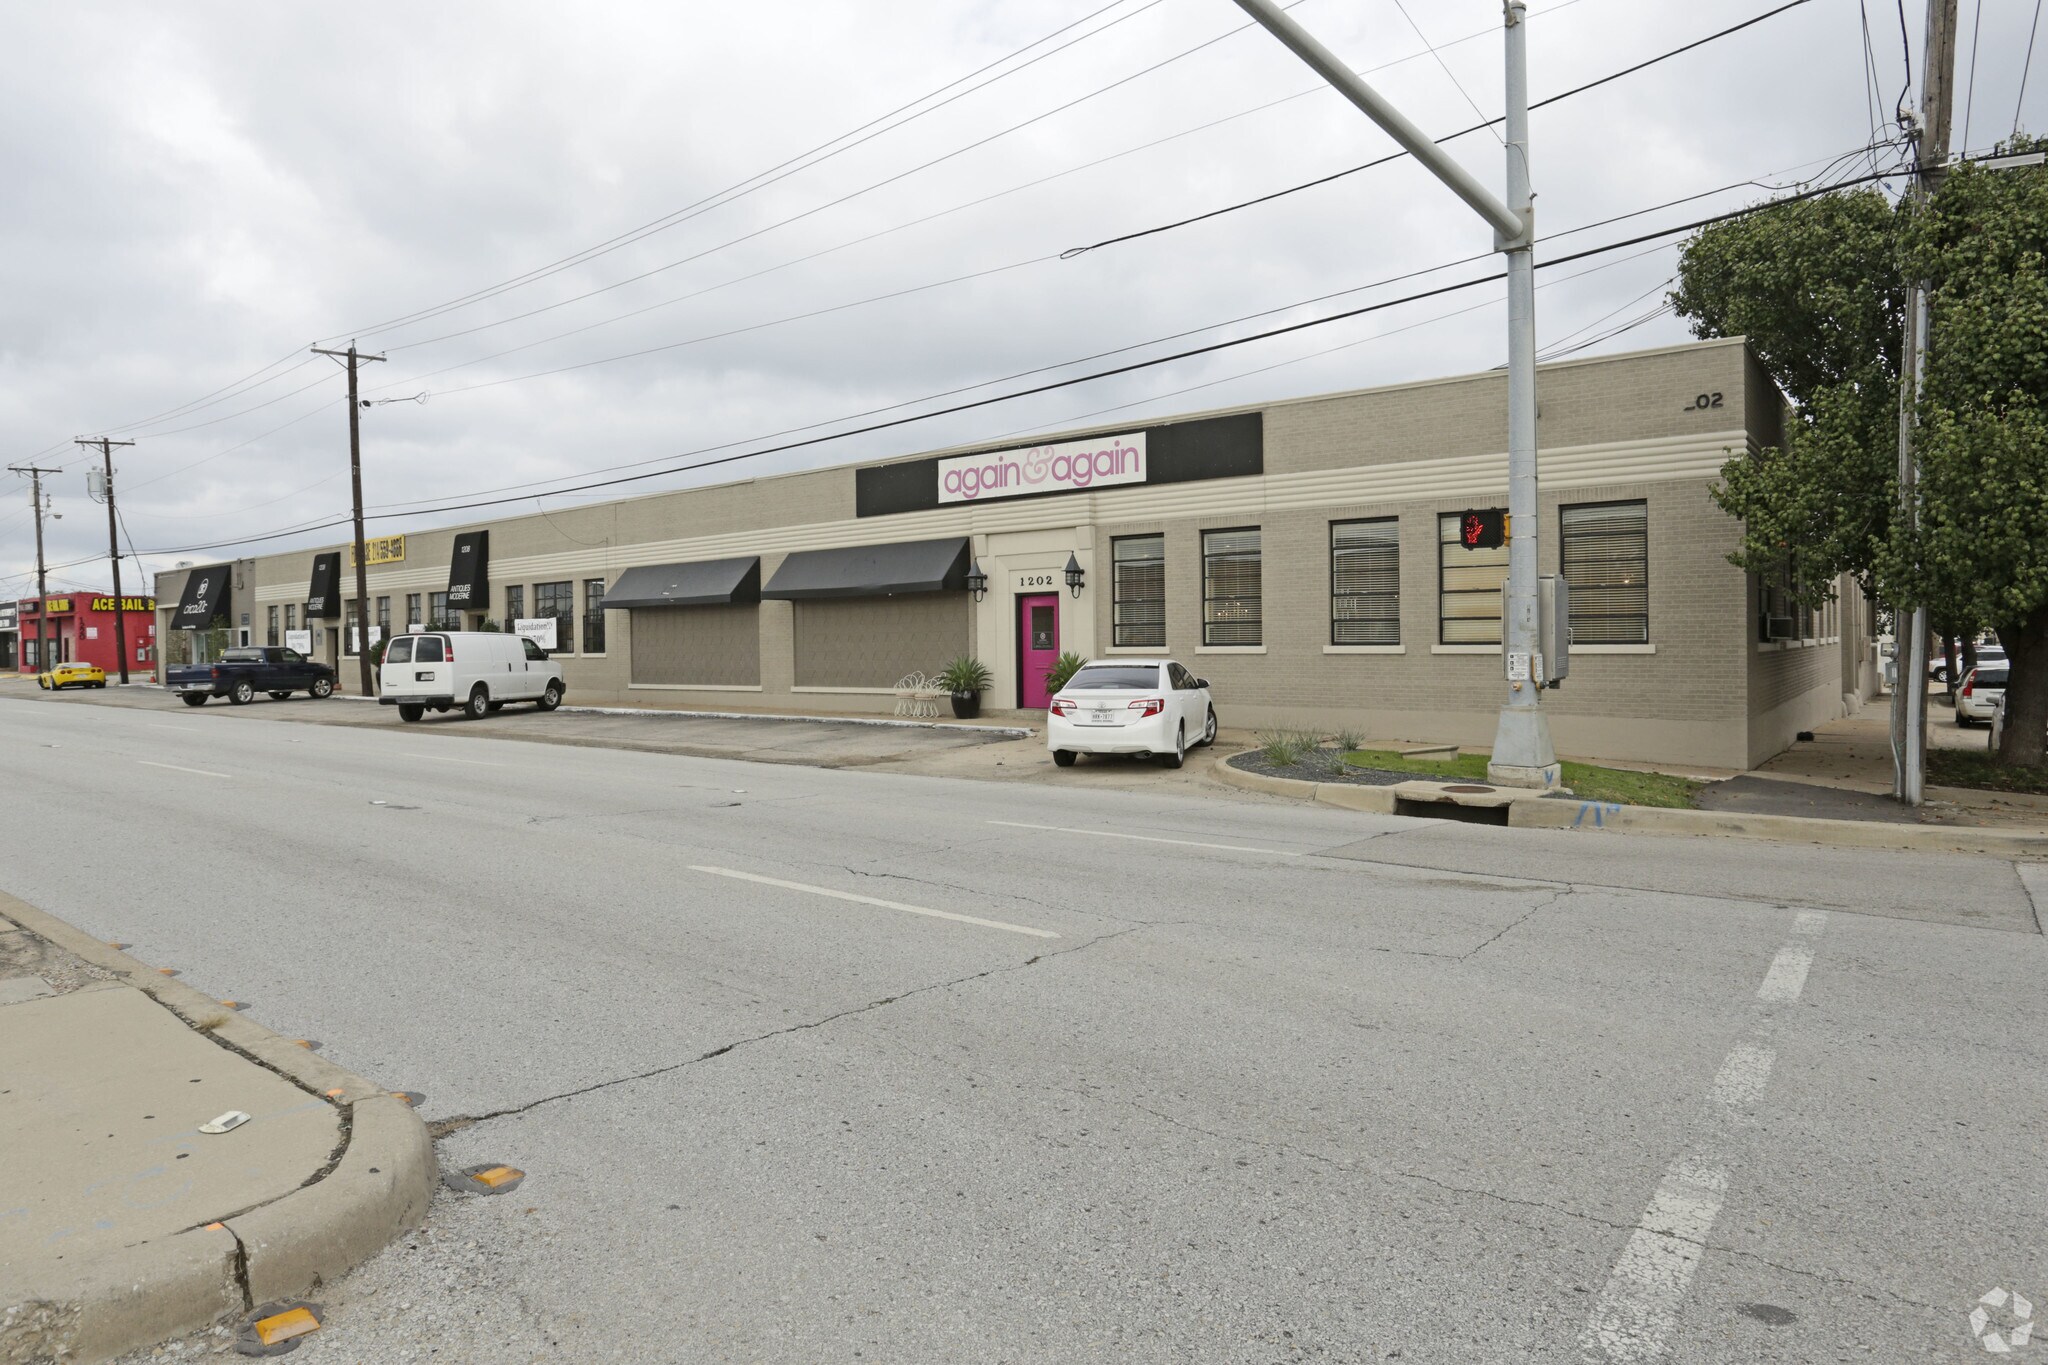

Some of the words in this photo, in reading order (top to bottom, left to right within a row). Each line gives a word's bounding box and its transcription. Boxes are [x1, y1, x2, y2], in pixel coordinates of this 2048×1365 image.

[1020, 575, 1053, 586] 1202
[450, 584, 471, 592] ANTIQUES
[92, 598, 115, 611] ACE
[121, 598, 145, 611] BAIL
